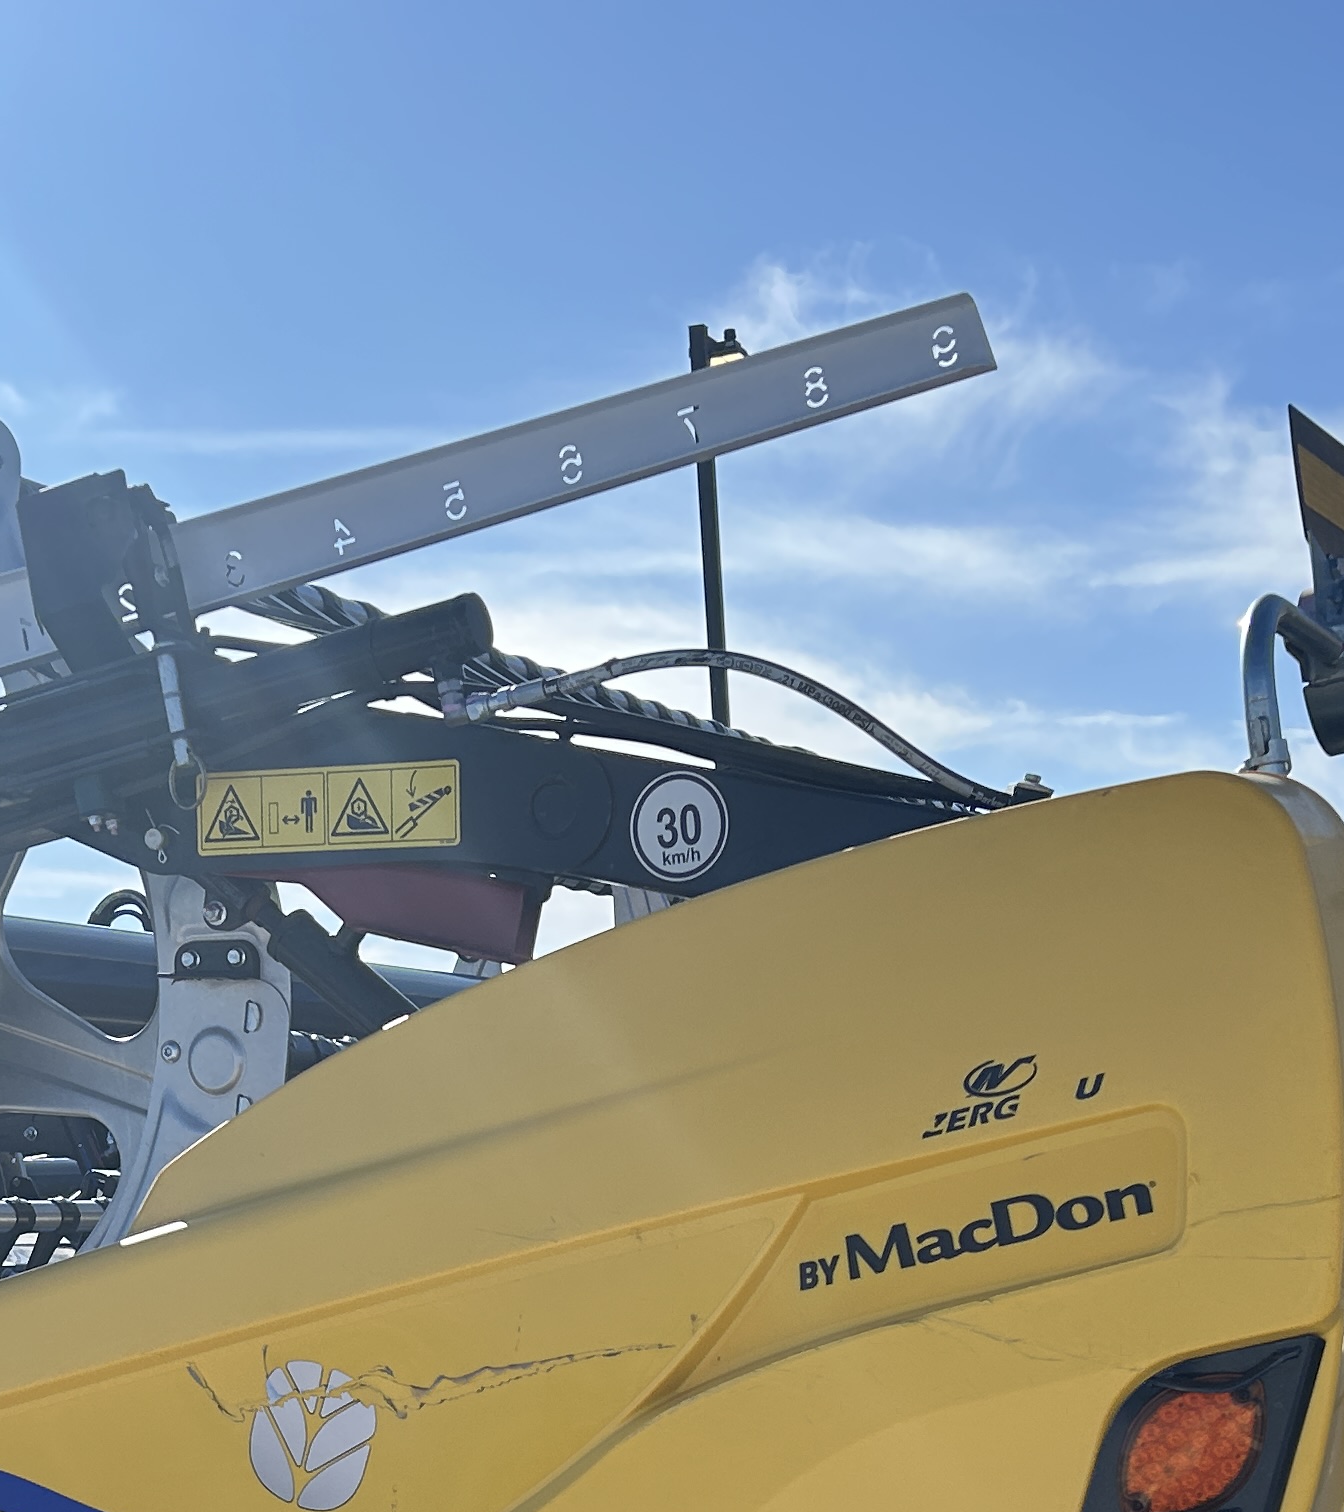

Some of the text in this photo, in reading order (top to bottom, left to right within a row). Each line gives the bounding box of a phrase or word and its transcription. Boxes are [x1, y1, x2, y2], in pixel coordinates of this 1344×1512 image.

[333, 518, 356, 556] 4
[442, 480, 468, 521] 5
[558, 444, 583, 485] 6
[676, 404, 700, 445] 7
[804, 366, 830, 409] 8
[931, 325, 959, 368] 9
[656, 803, 702, 849] 30
[662, 846, 701, 867] km/h
[1075, 1072, 1106, 1099] U
[799, 1182, 1154, 1291] BY MacDon
